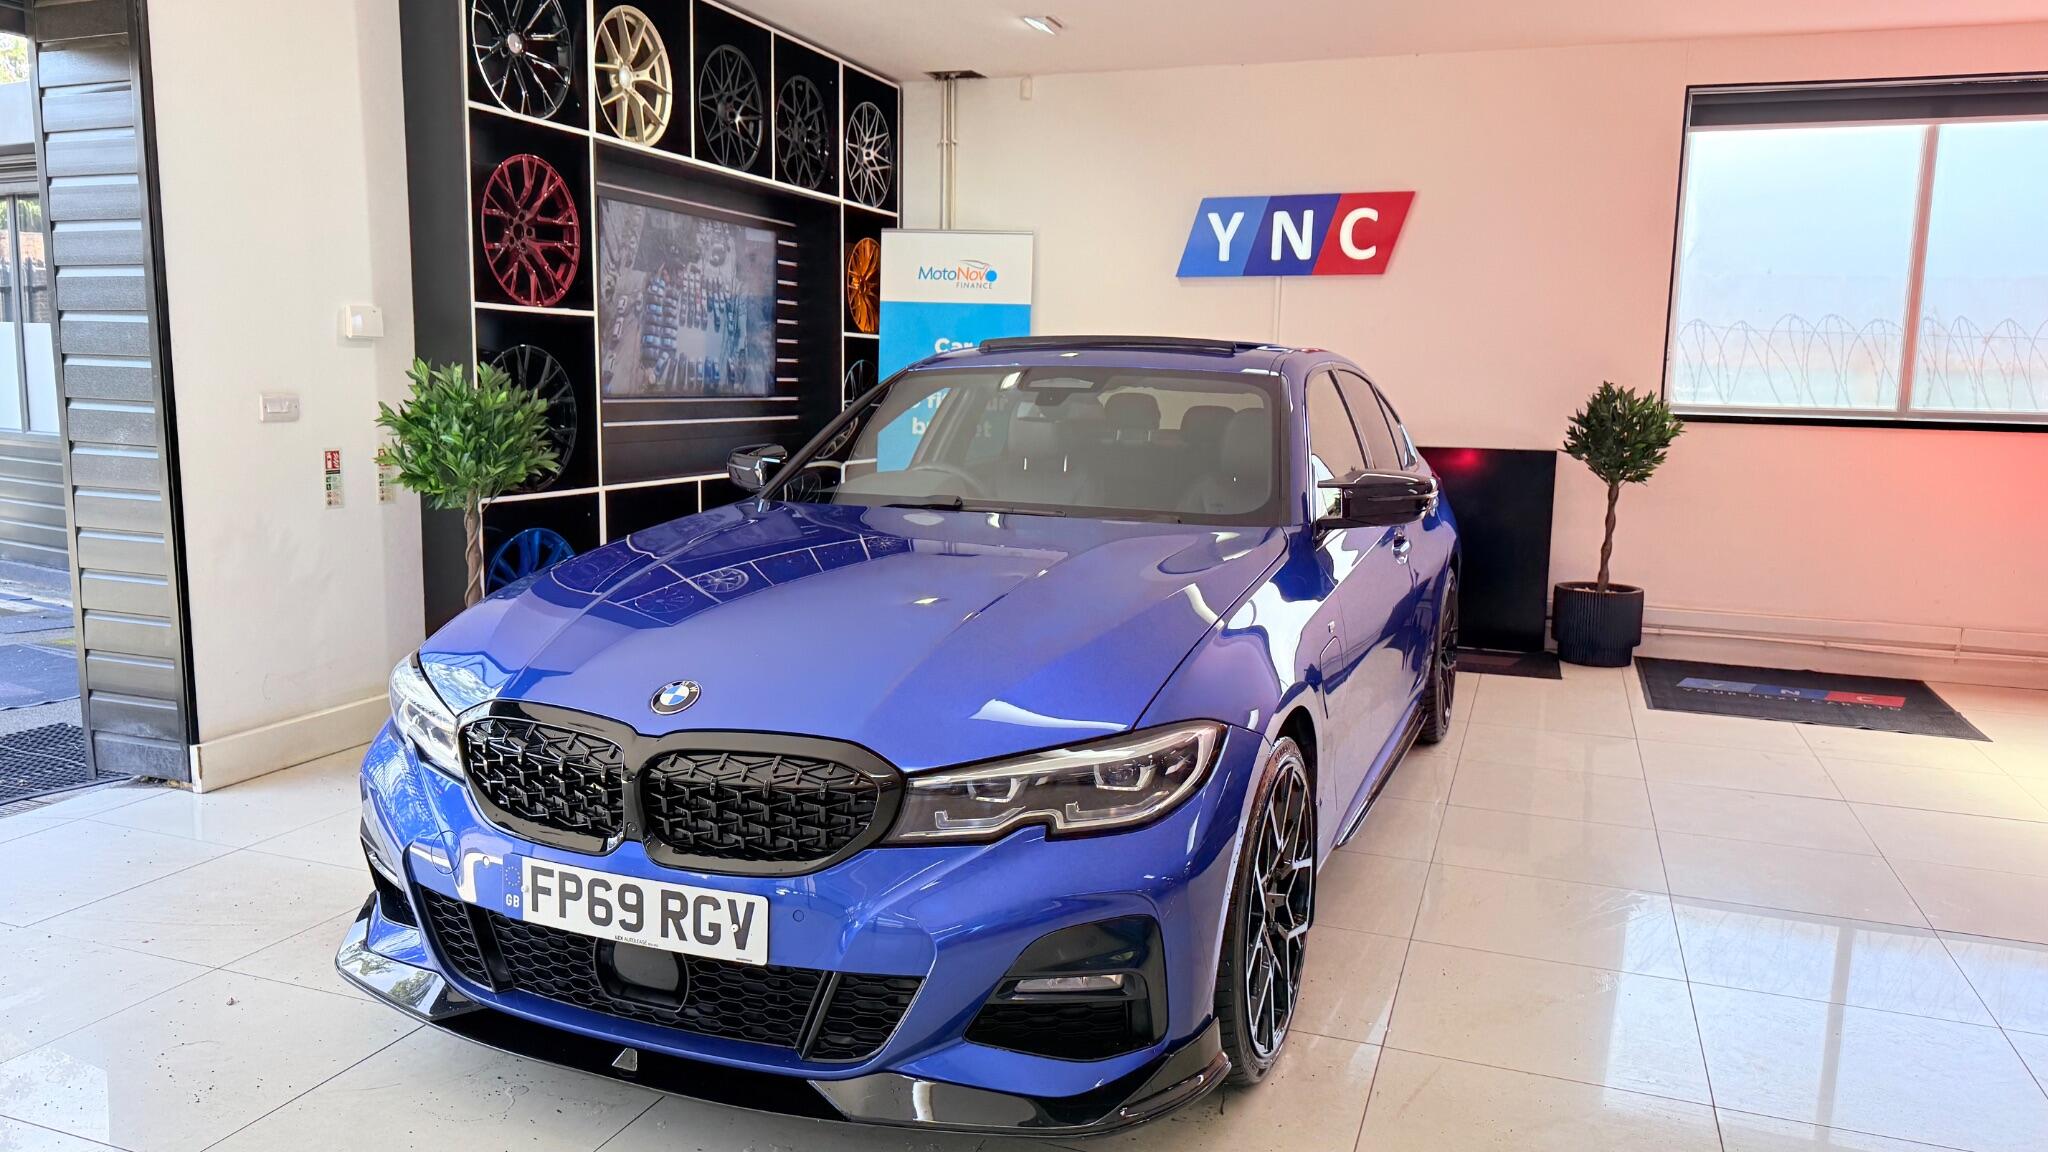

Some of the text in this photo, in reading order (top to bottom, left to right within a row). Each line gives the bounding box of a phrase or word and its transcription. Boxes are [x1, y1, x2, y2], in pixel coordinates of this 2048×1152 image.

[1207, 207, 1379, 262] YNC
[955, 281, 993, 290] FINANCE
[934, 338, 974, 354] Car
[505, 893, 520, 908] GB
[530, 865, 756, 951] FP69 RGV
